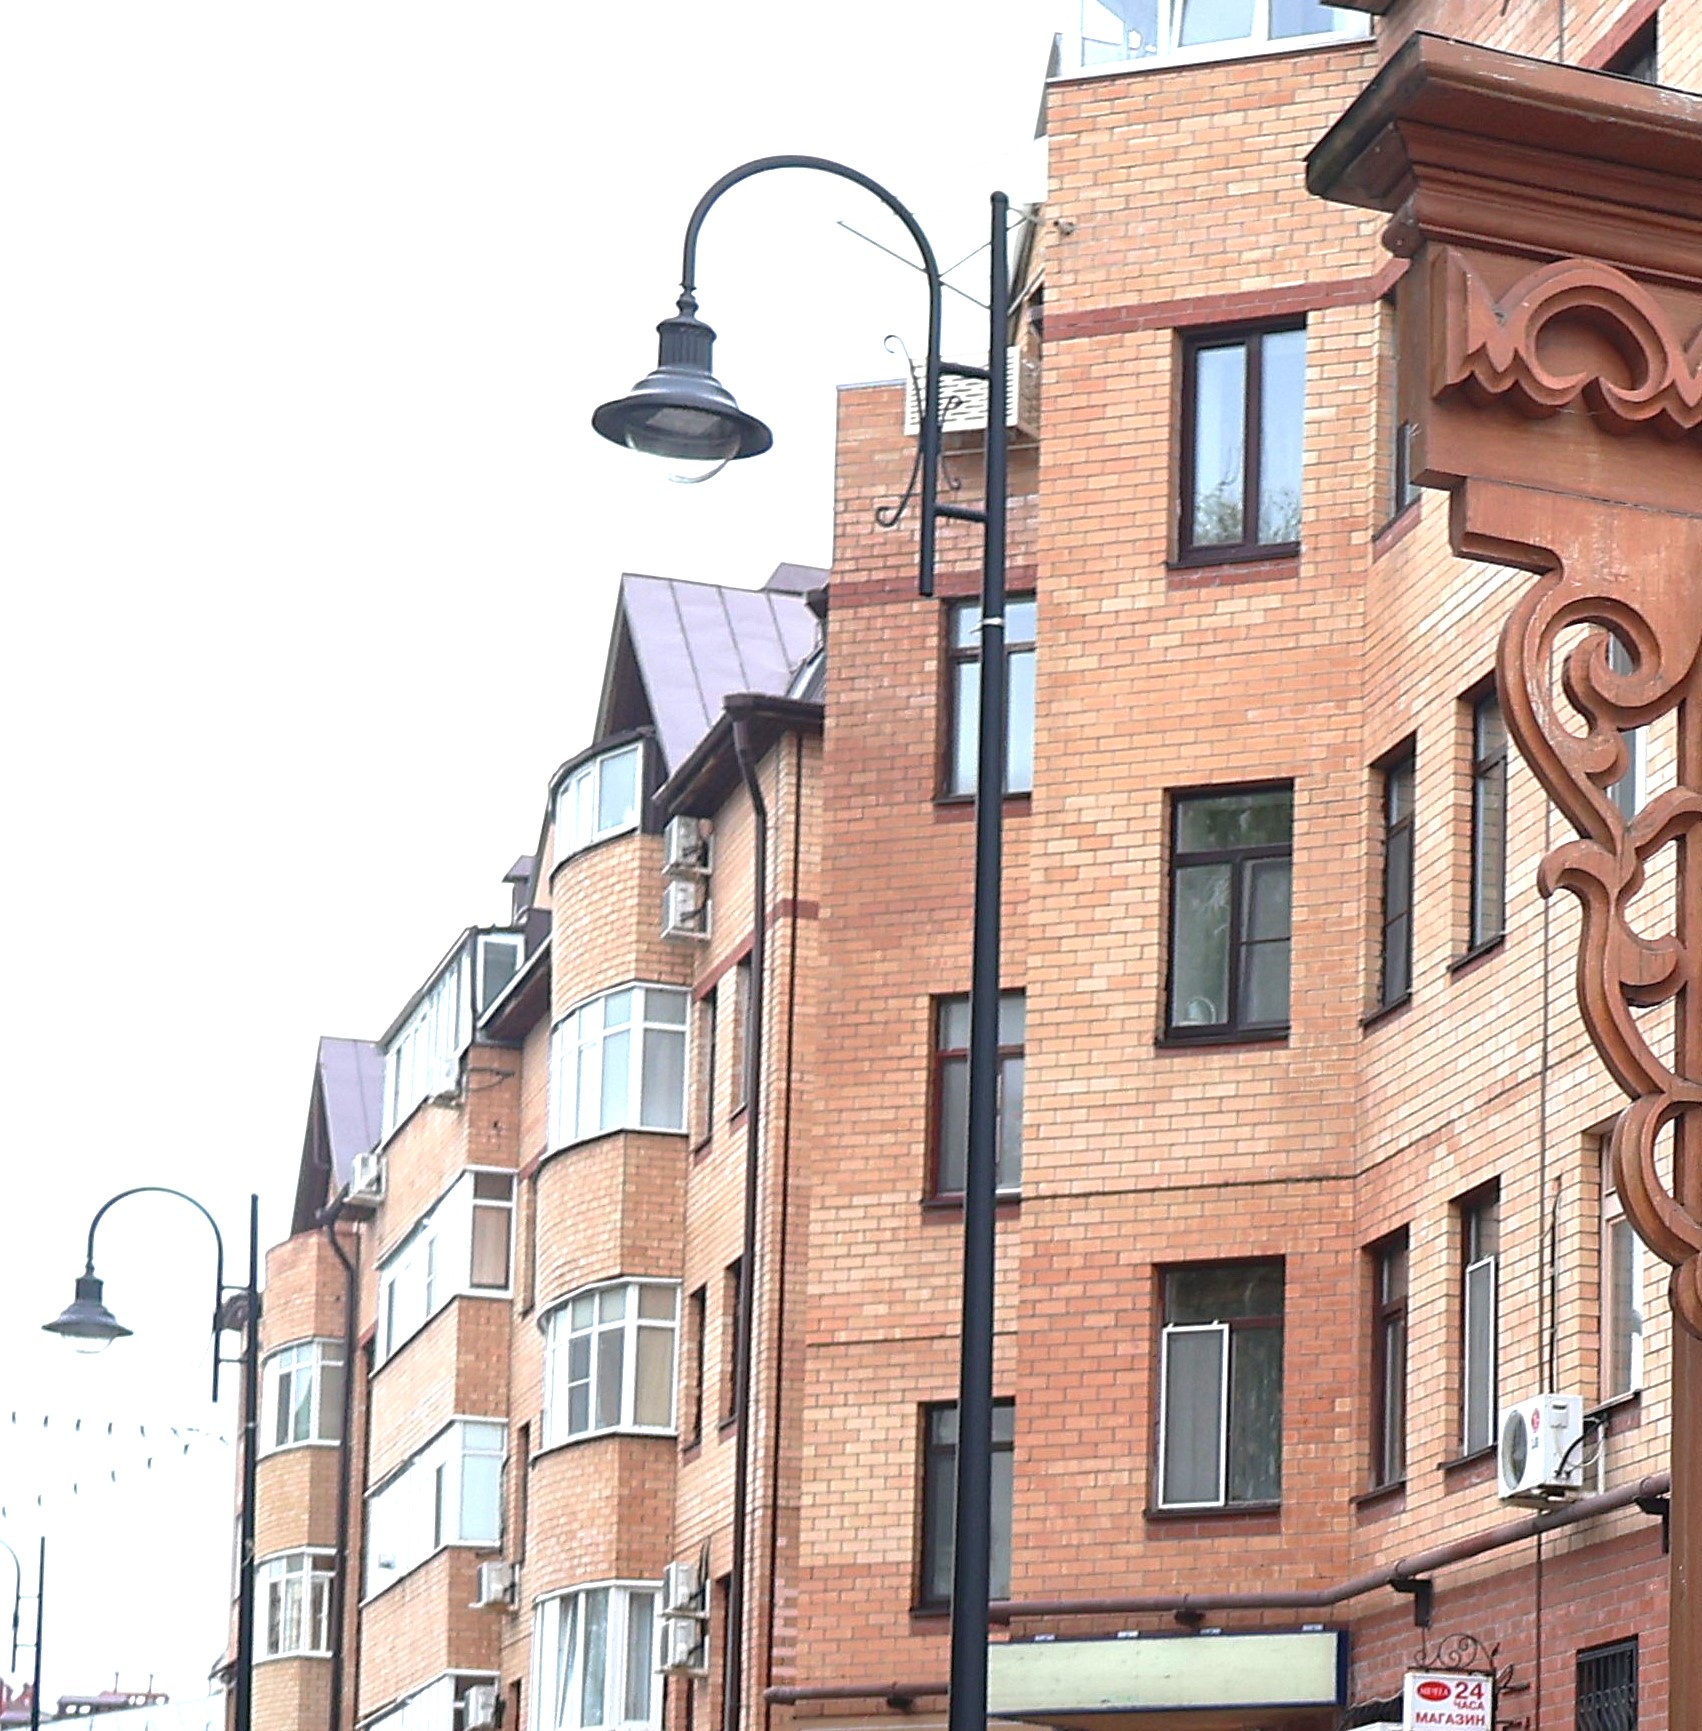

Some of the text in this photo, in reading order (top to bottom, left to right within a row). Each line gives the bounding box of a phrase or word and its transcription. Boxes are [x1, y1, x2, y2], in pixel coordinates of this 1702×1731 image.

[1454, 1681, 1484, 1700] 24
[1453, 1700, 1485, 1711] ЧАСА
[1416, 1711, 1486, 1726] МАГАЗИН
